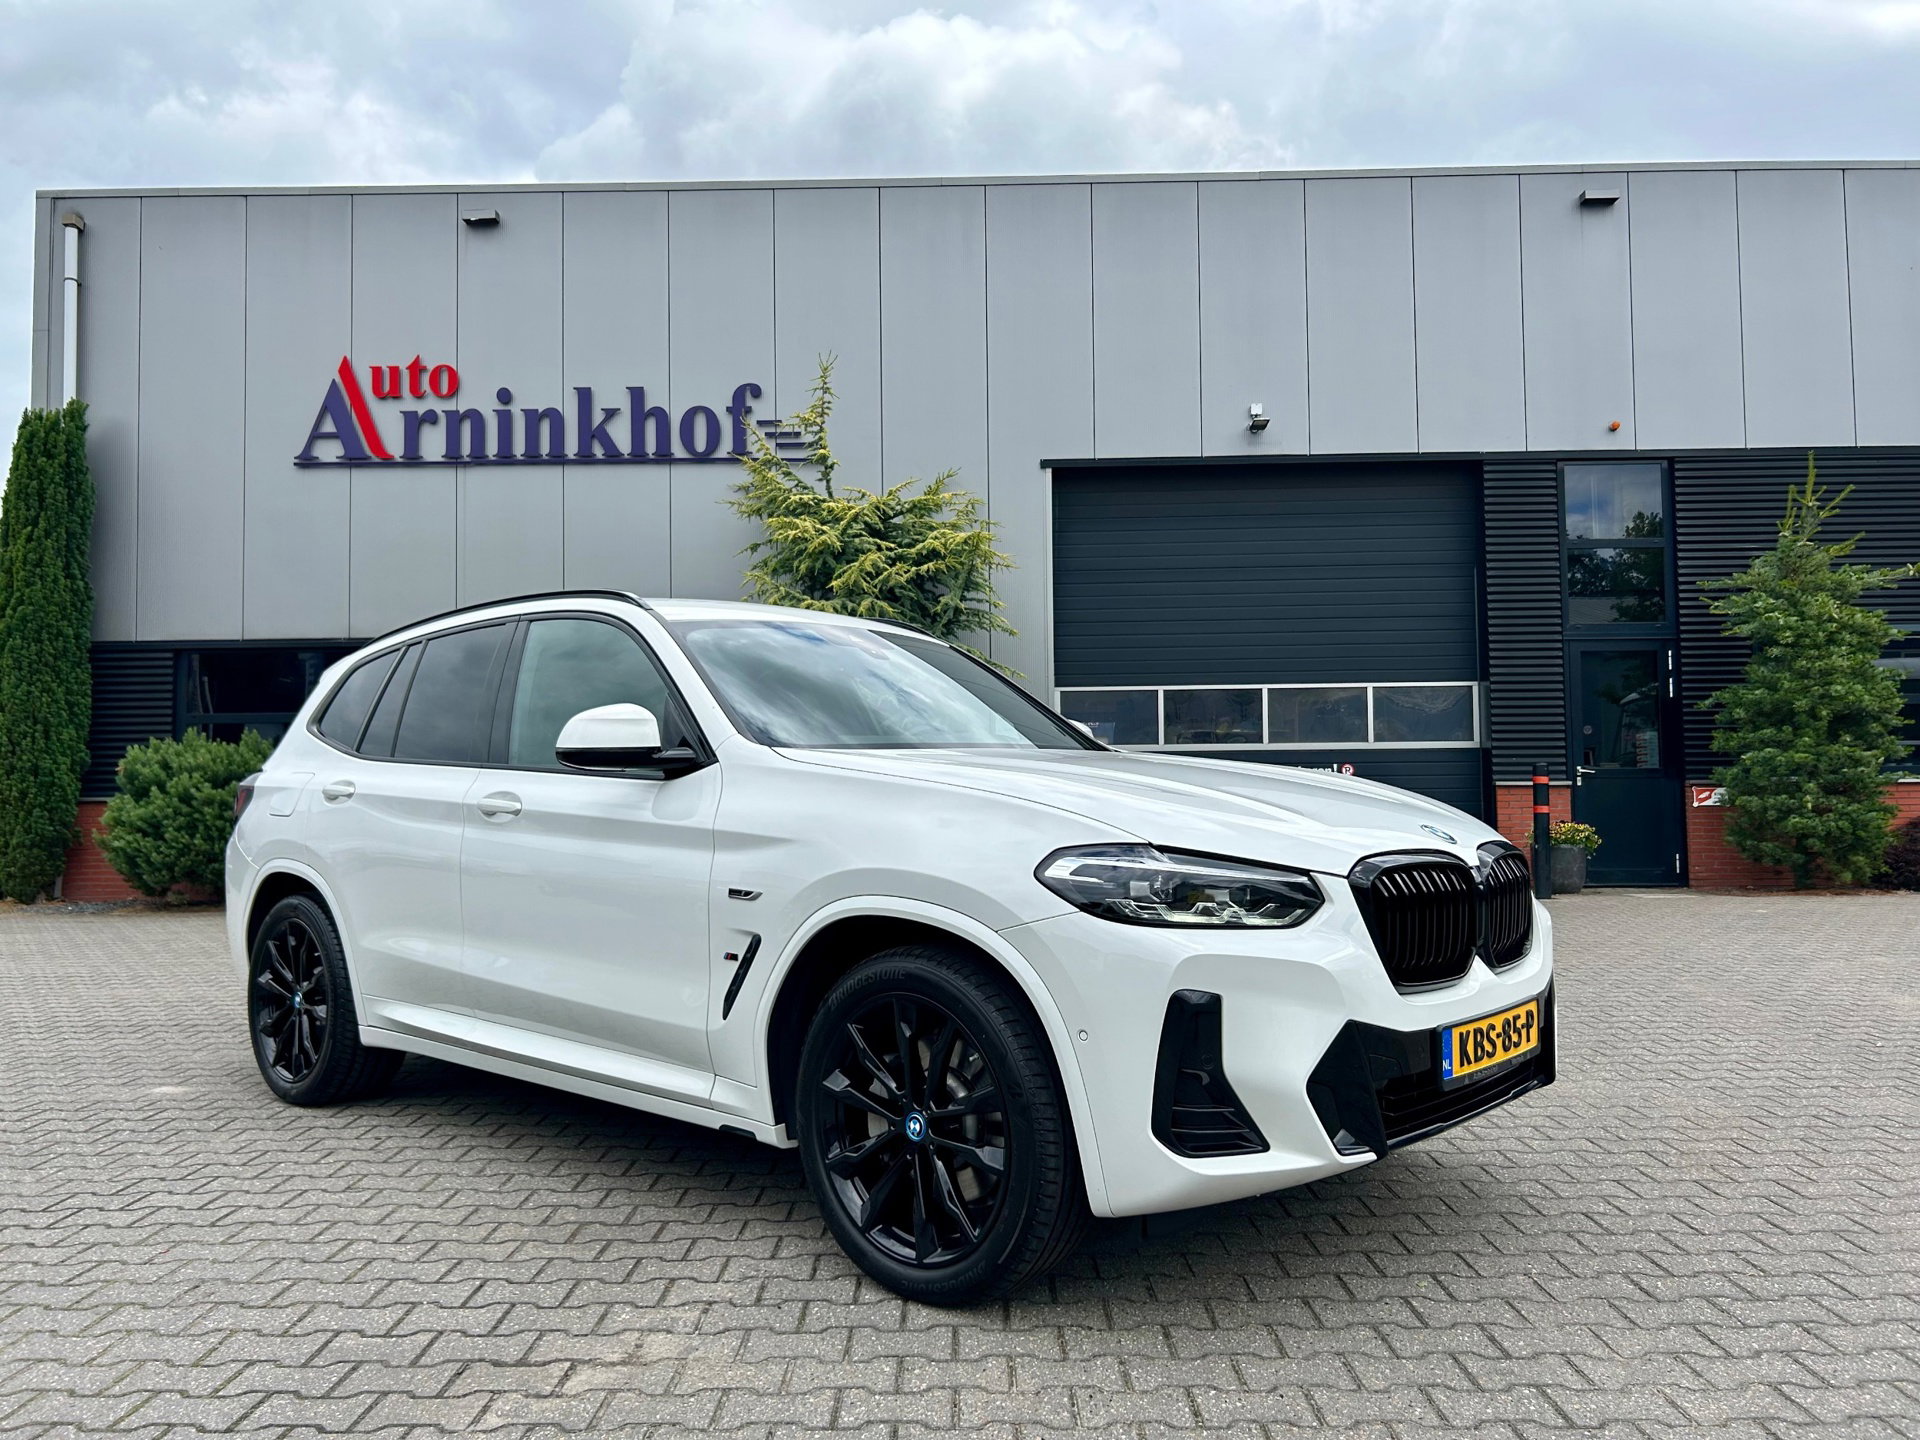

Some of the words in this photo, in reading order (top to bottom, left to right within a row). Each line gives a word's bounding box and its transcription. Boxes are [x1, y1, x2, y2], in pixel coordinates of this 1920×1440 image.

[294, 376, 762, 460] Arninkhof
[1443, 1058, 1451, 1071] NL
[1459, 1009, 1534, 1068] KBS-85-P
